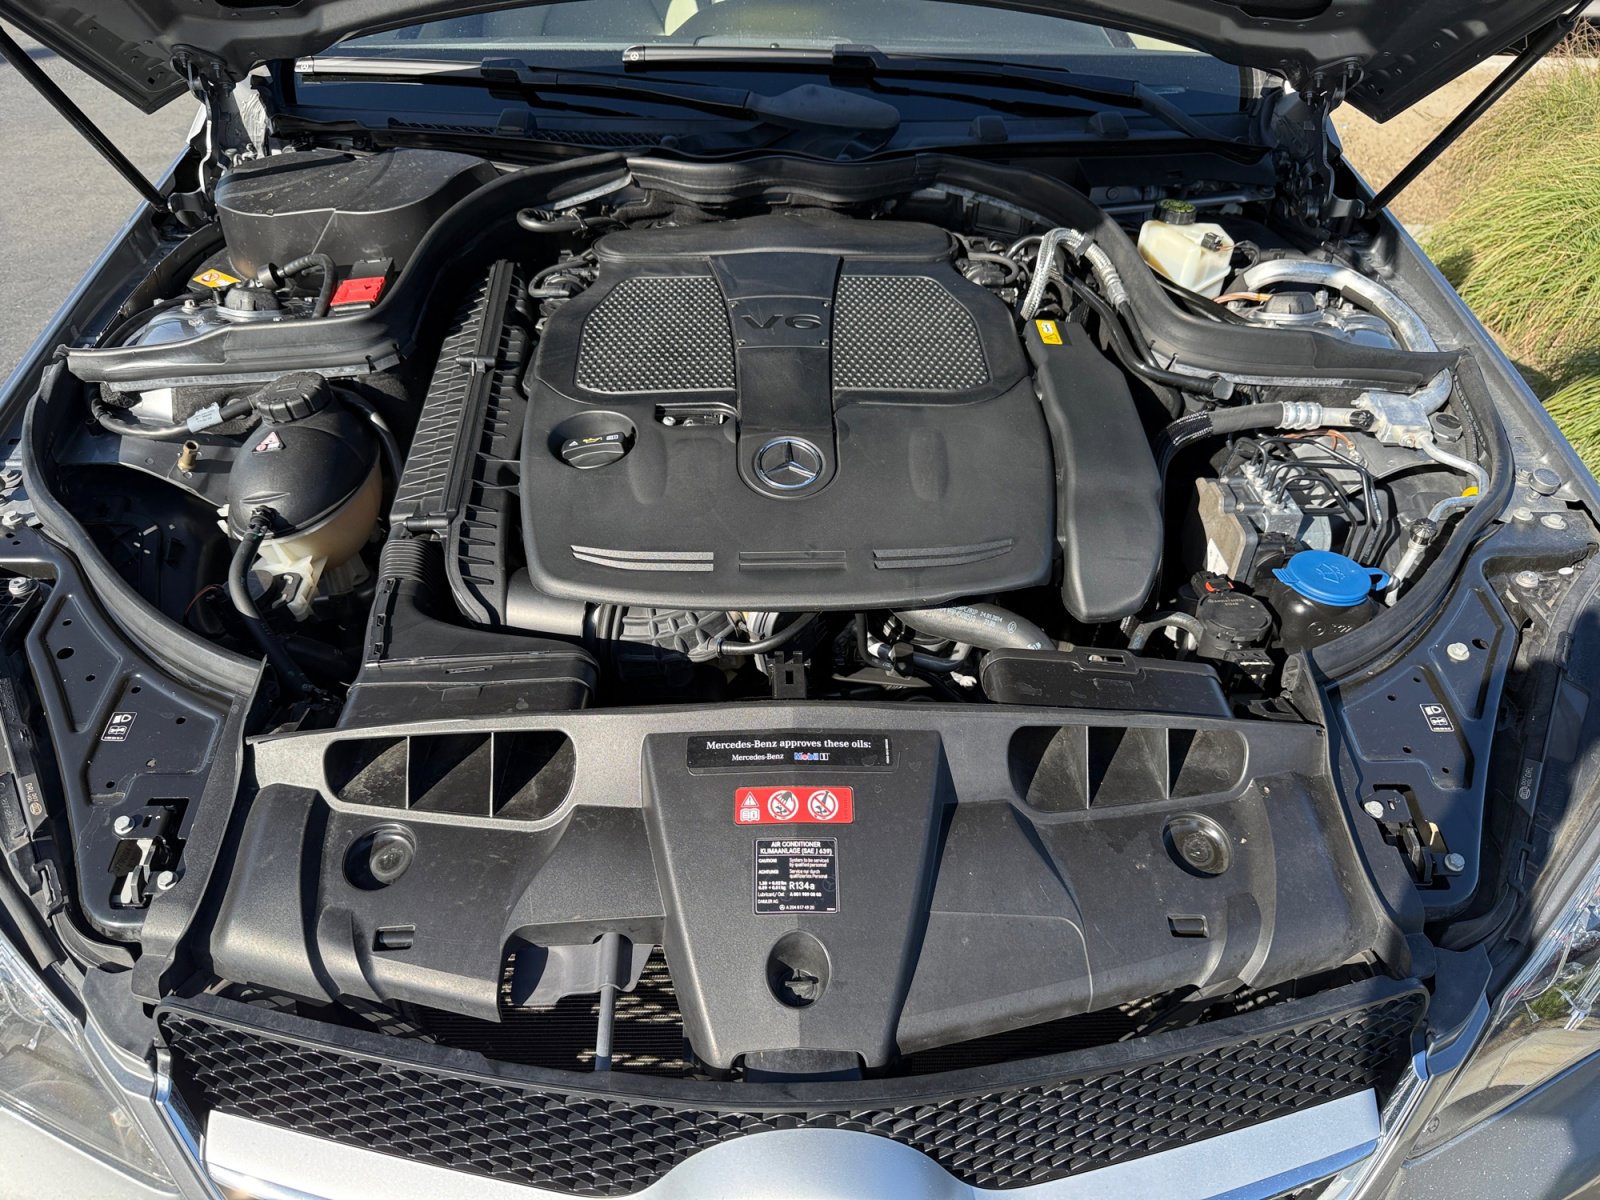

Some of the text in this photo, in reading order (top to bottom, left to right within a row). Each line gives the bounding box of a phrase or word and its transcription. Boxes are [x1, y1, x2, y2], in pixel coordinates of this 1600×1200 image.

[740, 313, 823, 330] V6
[706, 739, 872, 750] Mercedes-Benz approves these oils:
[794, 752, 819, 760] Mobil
